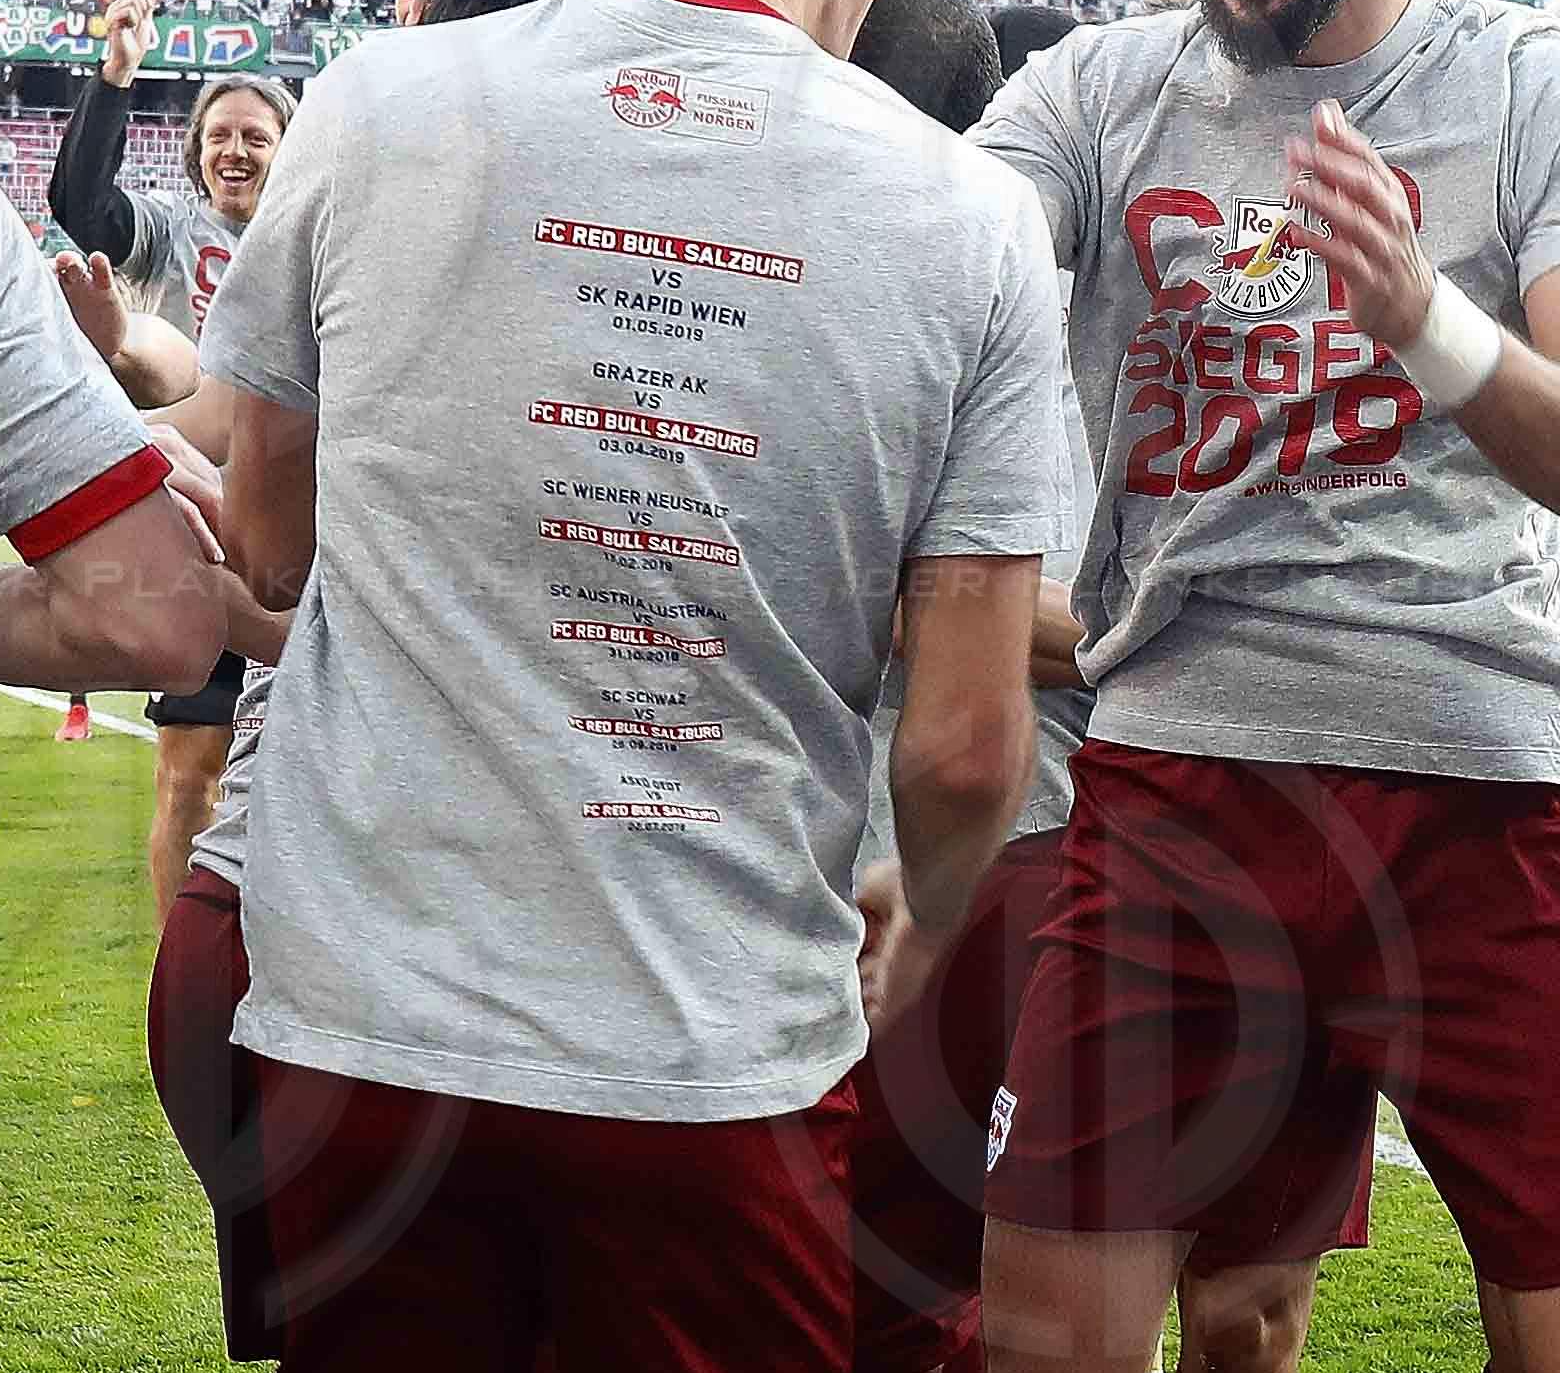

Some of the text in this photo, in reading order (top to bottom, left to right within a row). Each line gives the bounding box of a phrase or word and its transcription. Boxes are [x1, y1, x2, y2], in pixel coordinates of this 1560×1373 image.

[538, 221, 799, 281] FC RED BULL SALZBURG
[651, 268, 682, 288] VS
[577, 285, 746, 328] SK RAPID WIEN
[613, 316, 704, 341] 01.05.2019
[1127, 319, 1390, 394] SIEGE
[593, 362, 708, 395] GRAZER AK
[634, 391, 661, 409] VS
[530, 403, 755, 455] FC RED BULL SALZBURG
[1127, 376, 1423, 496] 2019
[600, 439, 685, 464] 03.04.2019
[543, 480, 567, 497] SC
[573, 482, 640, 505] WIENER
[628, 511, 653, 526] VS
[540, 522, 738, 564] FC RED BULL SALZBURG
